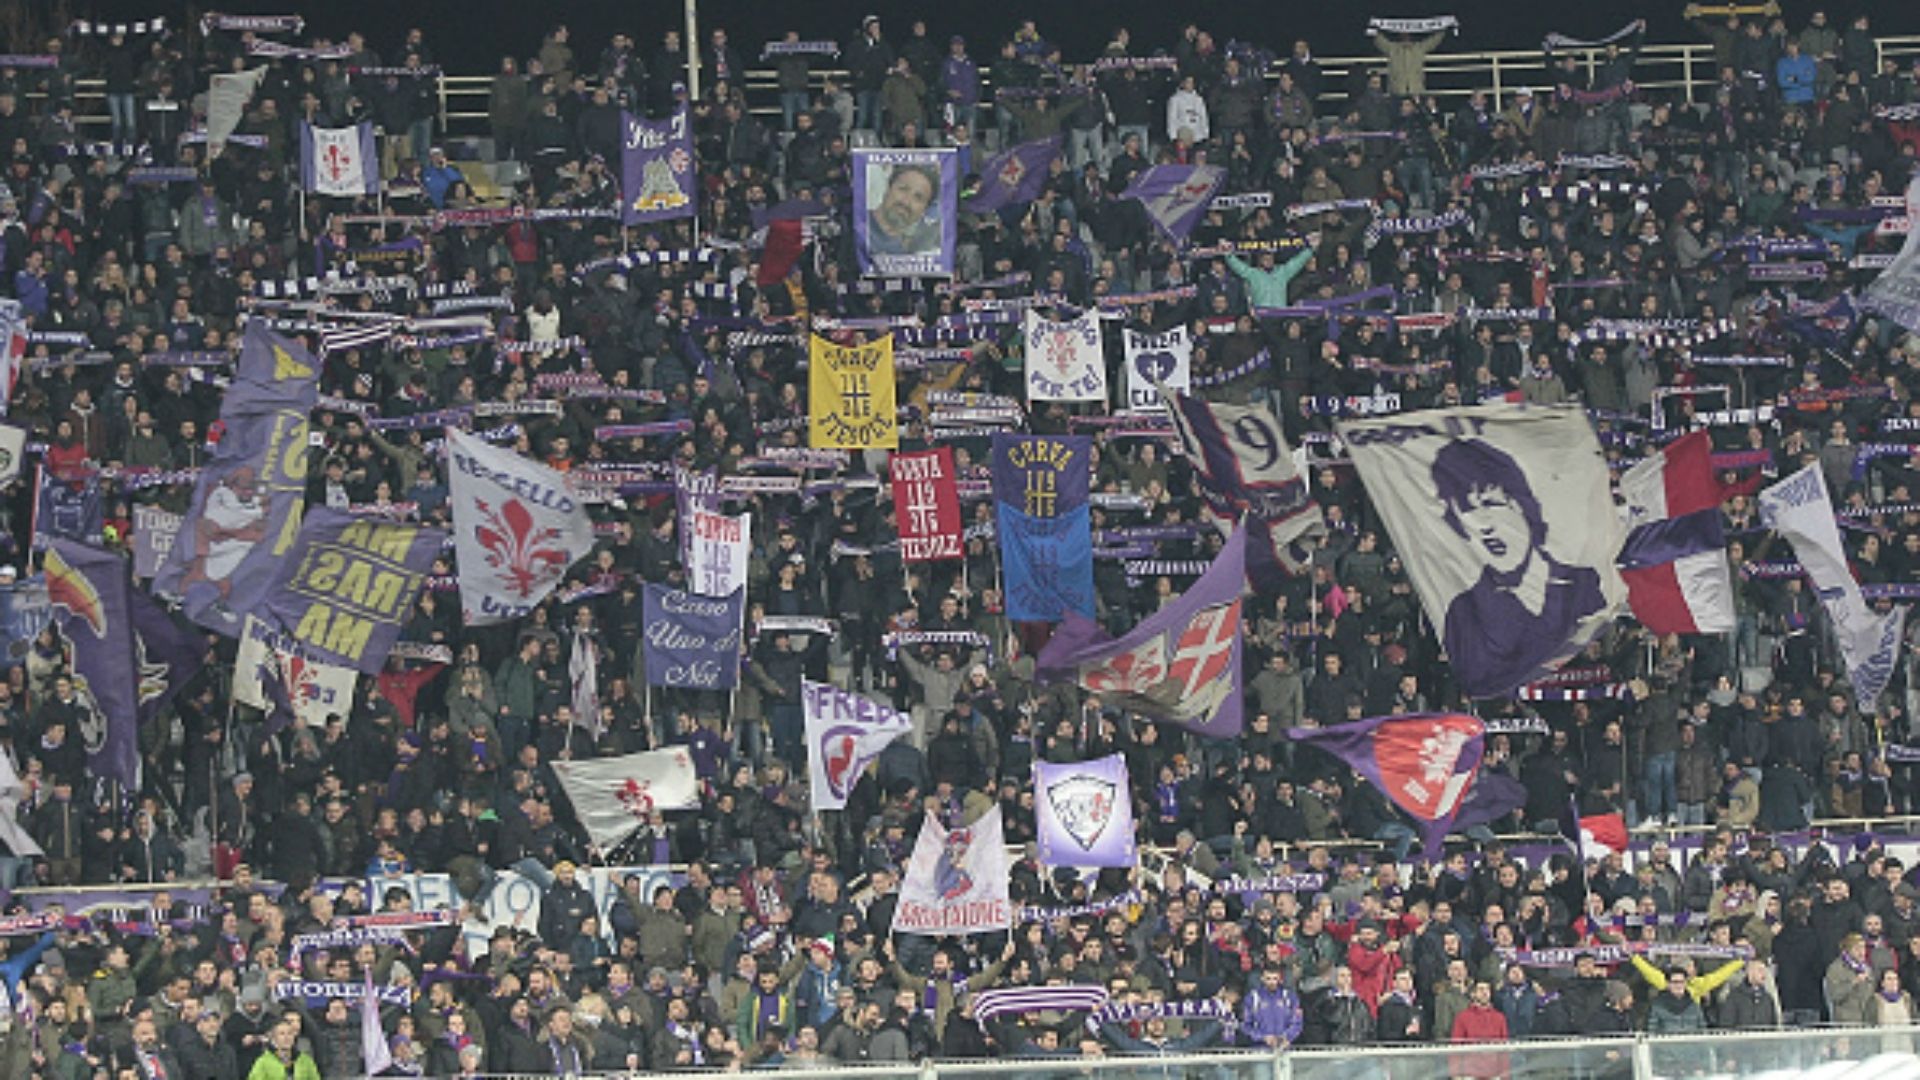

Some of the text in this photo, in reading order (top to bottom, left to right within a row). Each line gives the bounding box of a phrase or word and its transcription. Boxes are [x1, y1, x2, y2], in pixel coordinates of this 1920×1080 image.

[1030, 371, 1063, 397] PER
[1008, 441, 1073, 472] CURVA
[1235, 414, 1279, 471] 9
[892, 454, 943, 480] CURVA
[647, 620, 705, 651] Uno
[664, 660, 722, 687] Noi
